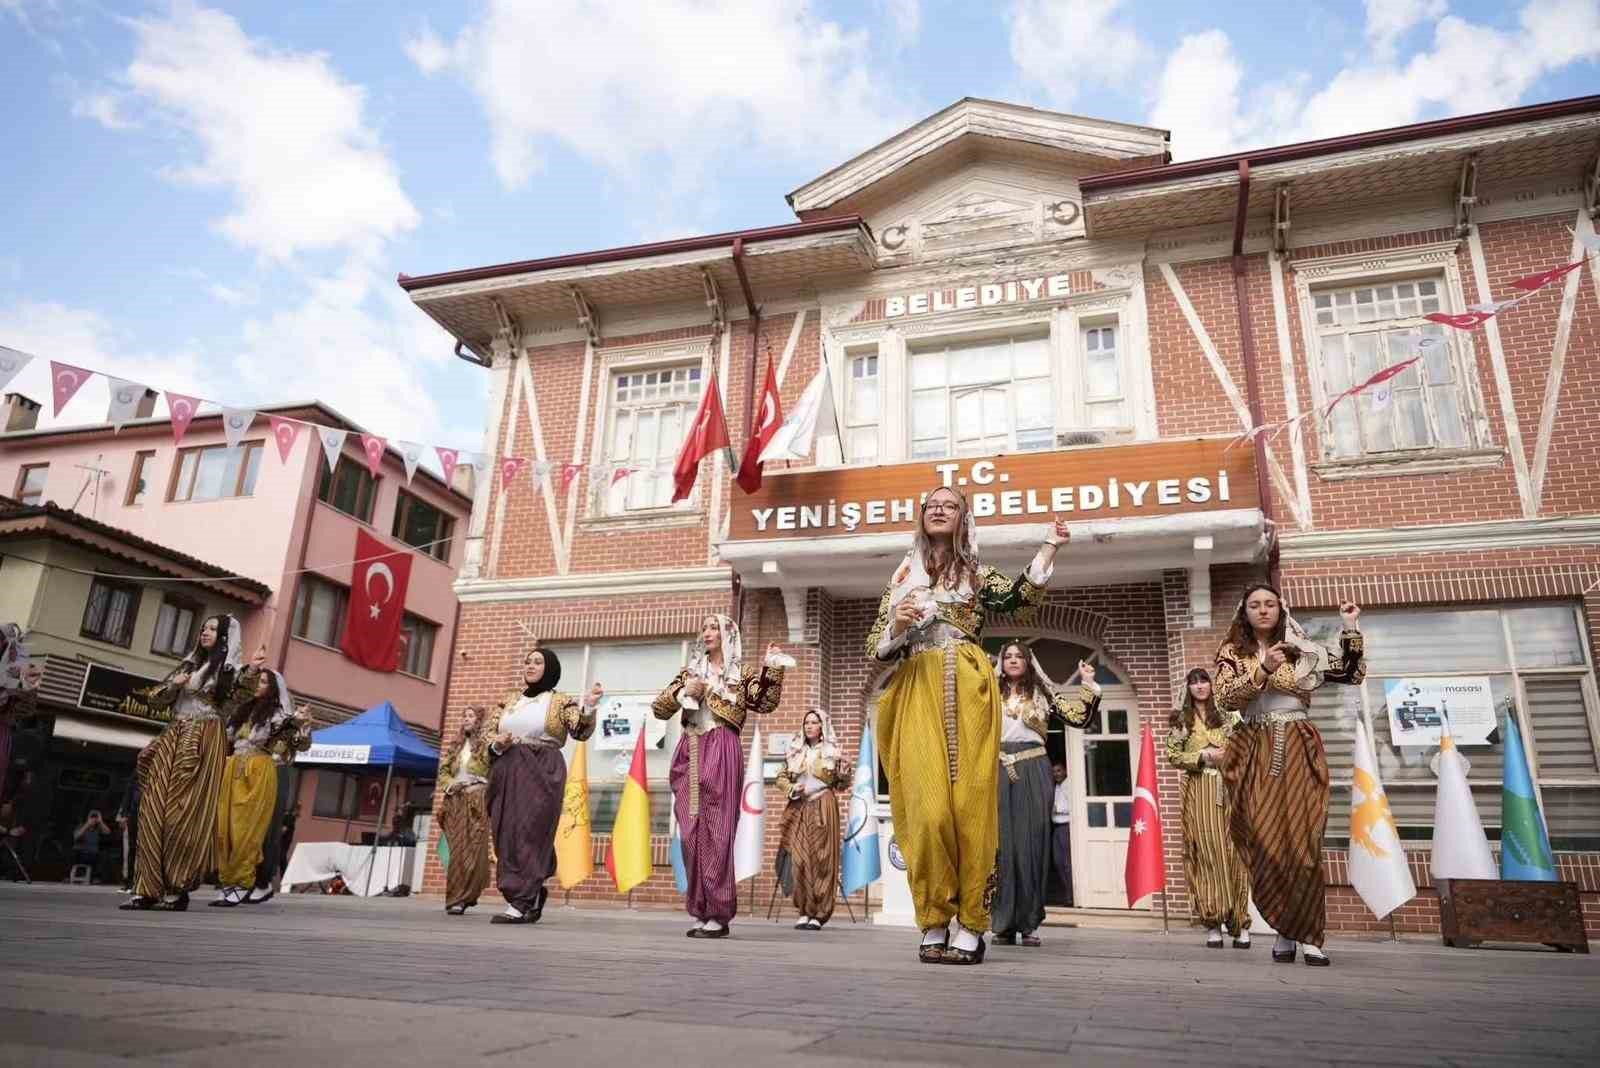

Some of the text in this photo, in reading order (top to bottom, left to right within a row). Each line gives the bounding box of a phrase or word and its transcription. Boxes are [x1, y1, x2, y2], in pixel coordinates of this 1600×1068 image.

[936, 461, 1009, 488] T.C.
[751, 470, 1230, 531] YENİŞEH BELEDİYESİ
